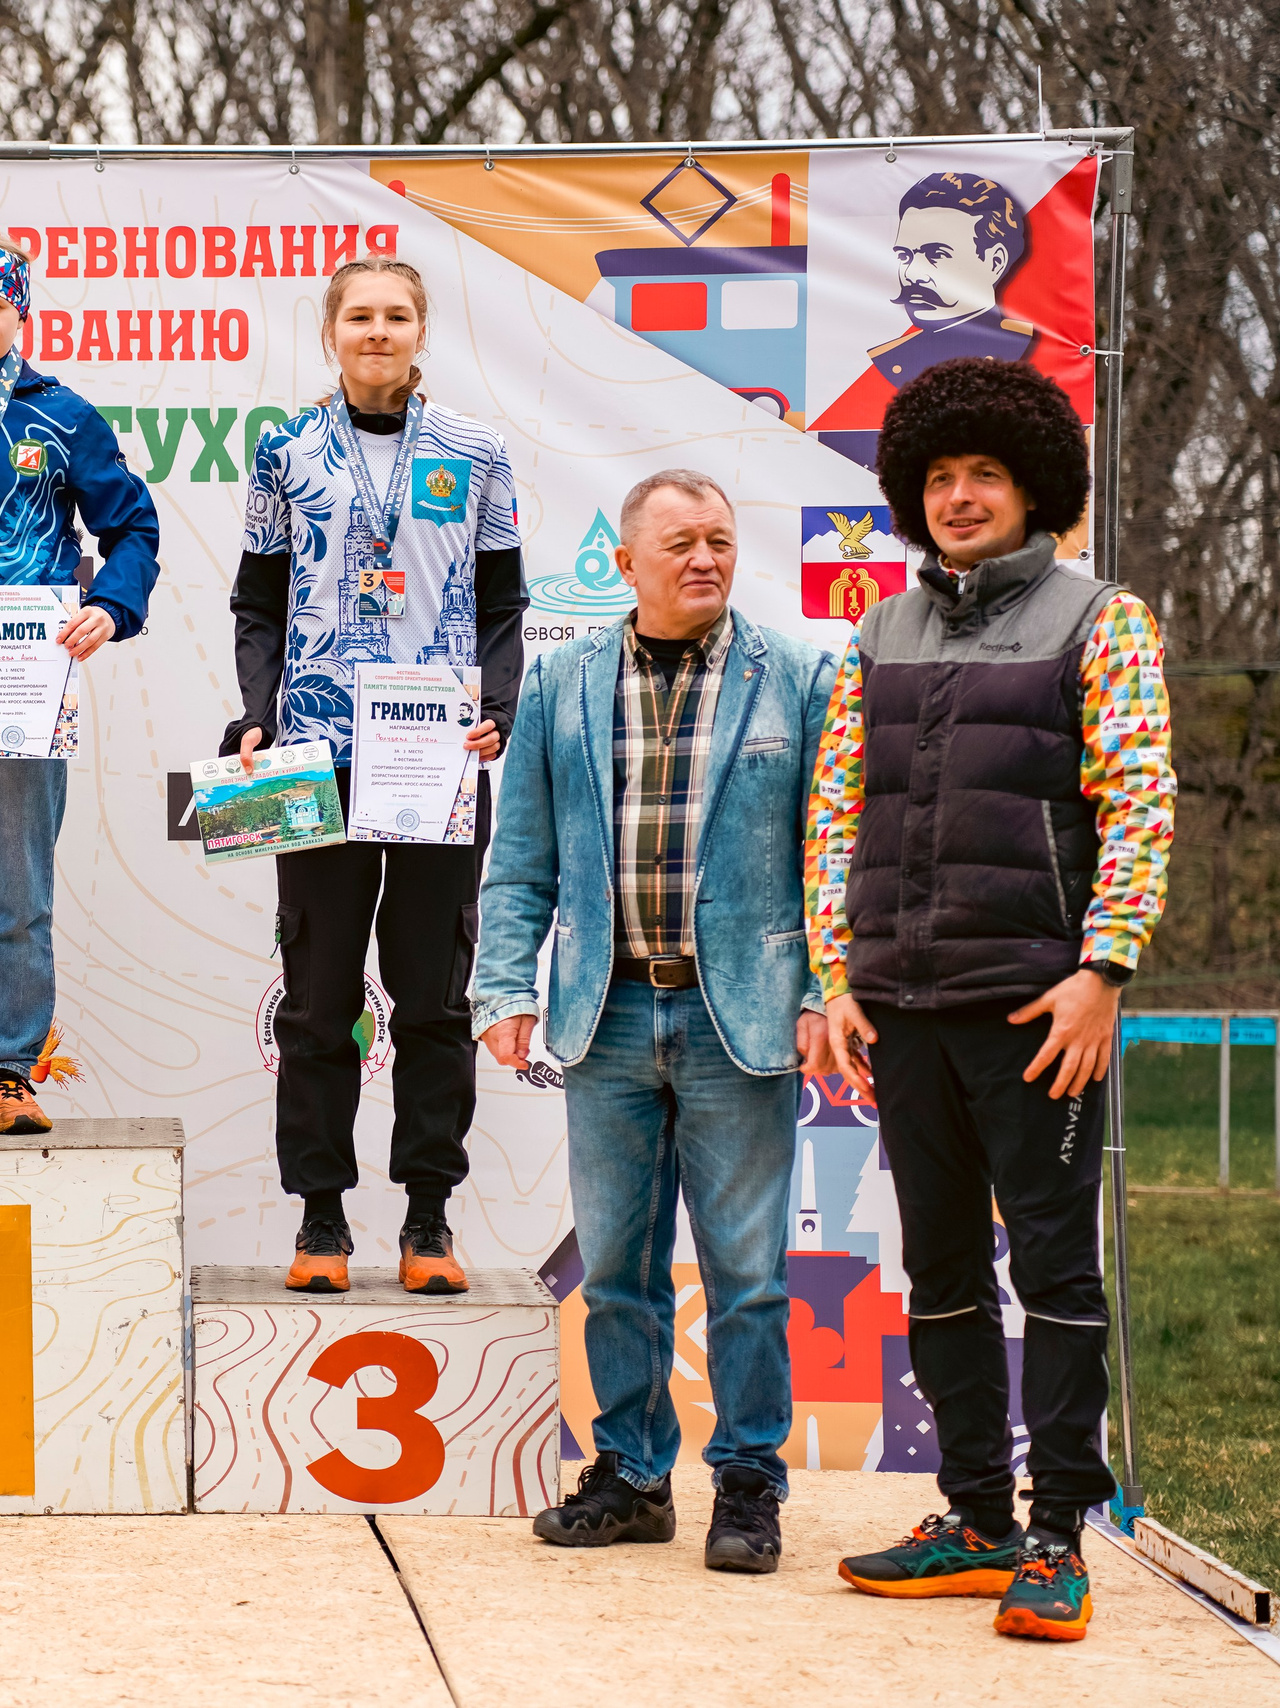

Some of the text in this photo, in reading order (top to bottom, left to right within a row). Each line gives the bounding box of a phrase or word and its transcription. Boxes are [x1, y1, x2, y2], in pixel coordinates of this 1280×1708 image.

[337, 424, 361, 480] СОРЕВНОВАНИЯ
[388, 421, 414, 505] ВОЕННОГО ТОПОГРАФА
[398, 452, 414, 494] ПАСТУХОВА
[363, 573, 374, 588] 3
[523, 626, 575, 641] евая
[370, 701, 448, 722] ГРАМОТА
[251, 770, 279, 780] СЛАДОСТИ
[282, 766, 305, 775] КУРОРТА
[207, 832, 263, 850] ПЯТИГОРСК
[254, 844, 290, 853] МИНЕРАЛЬНЫХ
[302, 837, 324, 846] КАВКАЗА
[263, 988, 284, 1046] Канатная
[363, 980, 387, 1044] Пятигорск
[305, 1331, 446, 1504] 3
